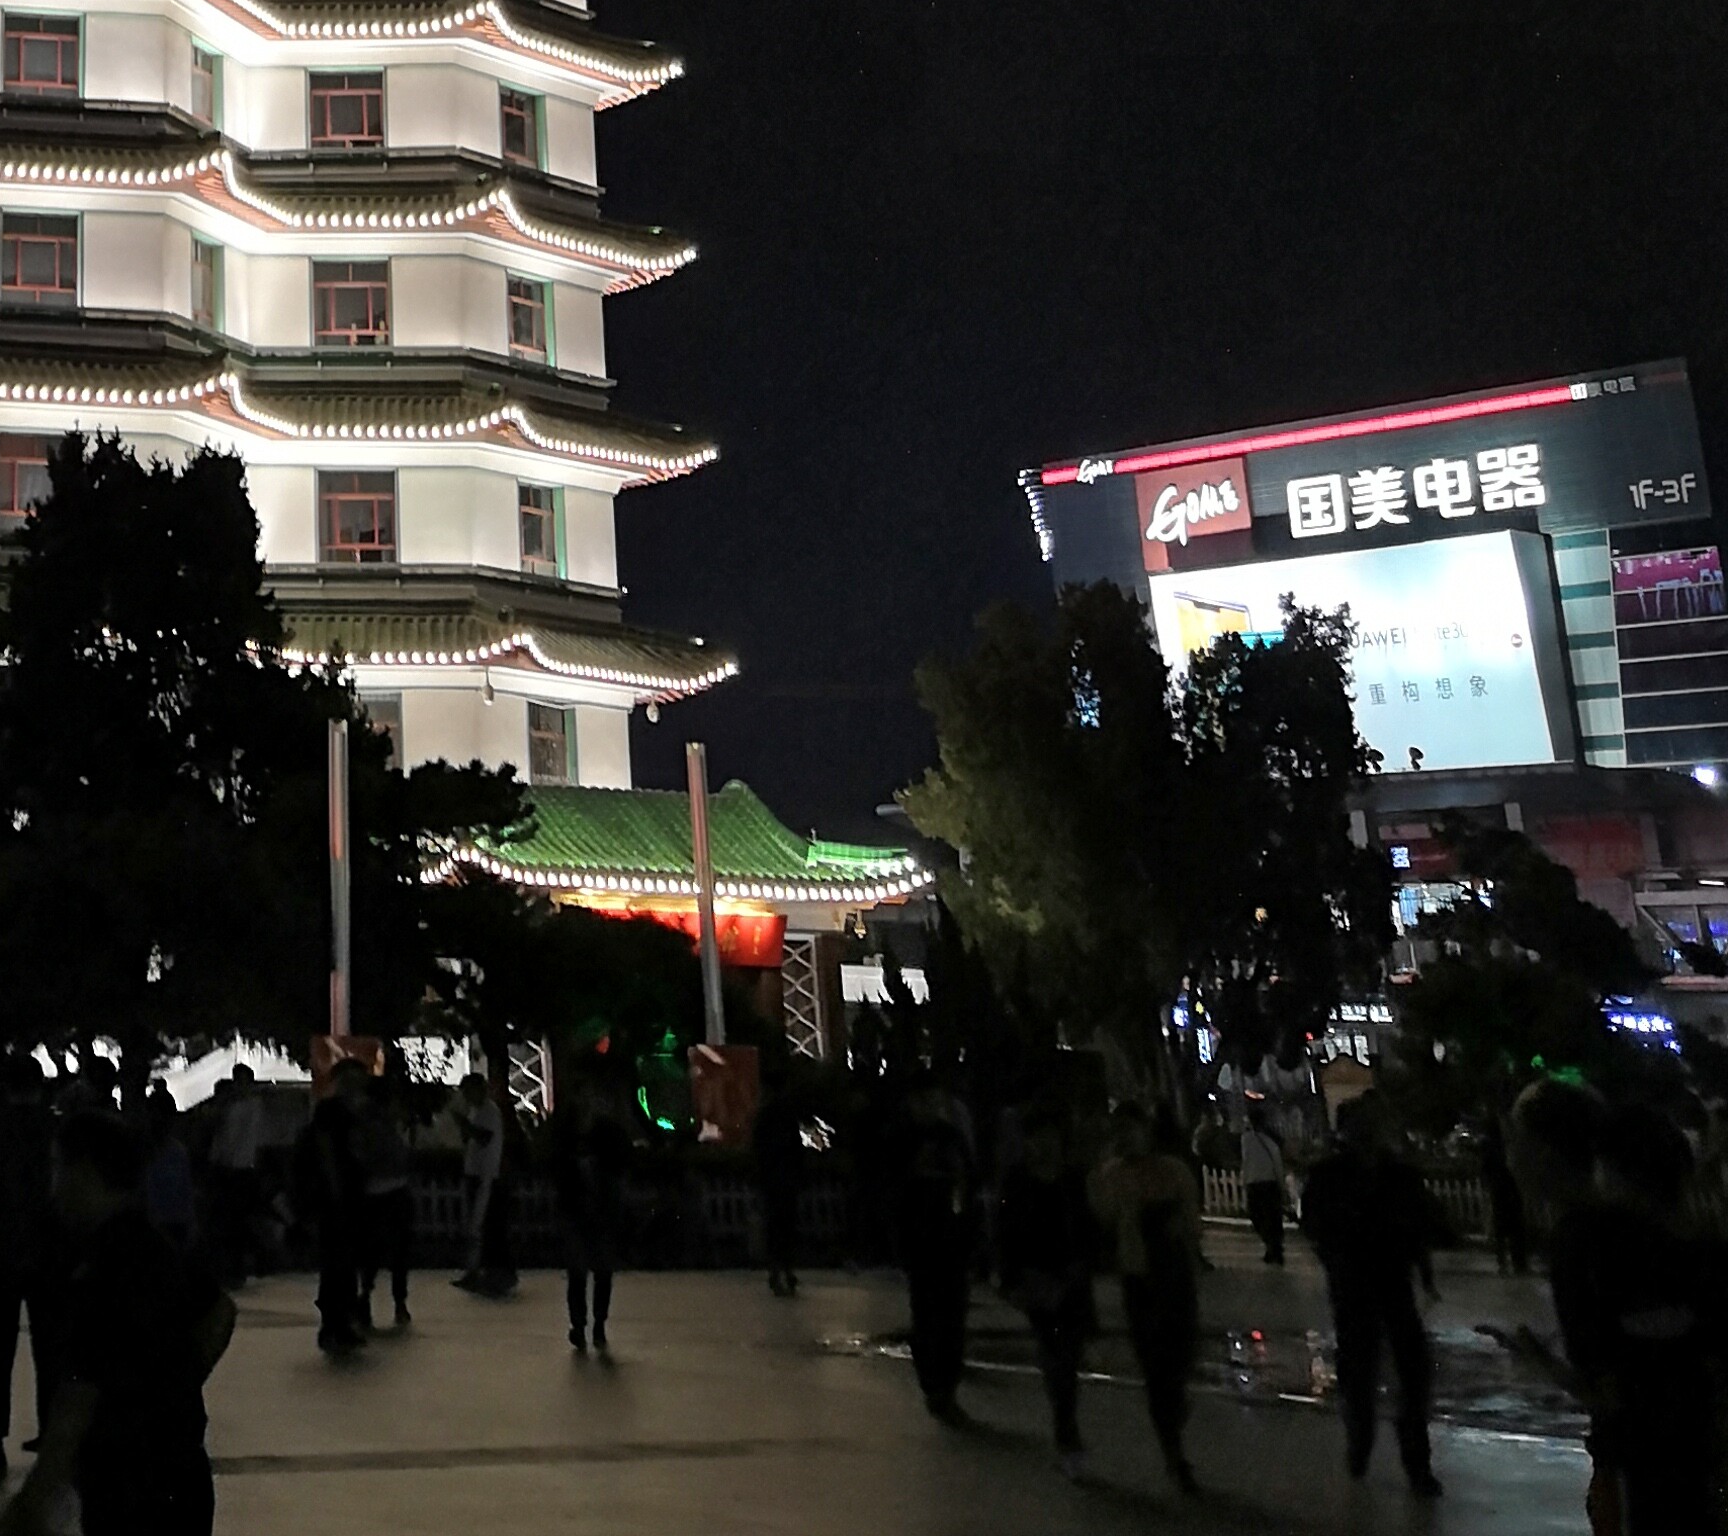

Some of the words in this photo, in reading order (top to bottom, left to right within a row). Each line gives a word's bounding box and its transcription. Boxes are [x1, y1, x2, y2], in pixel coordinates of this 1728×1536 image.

[1286, 443, 1545, 539] 国美电器
[1629, 473, 1696, 510] 1F-3F
[1349, 627, 1407, 649] UAWEI
[1370, 675, 1488, 705] 重构想象
